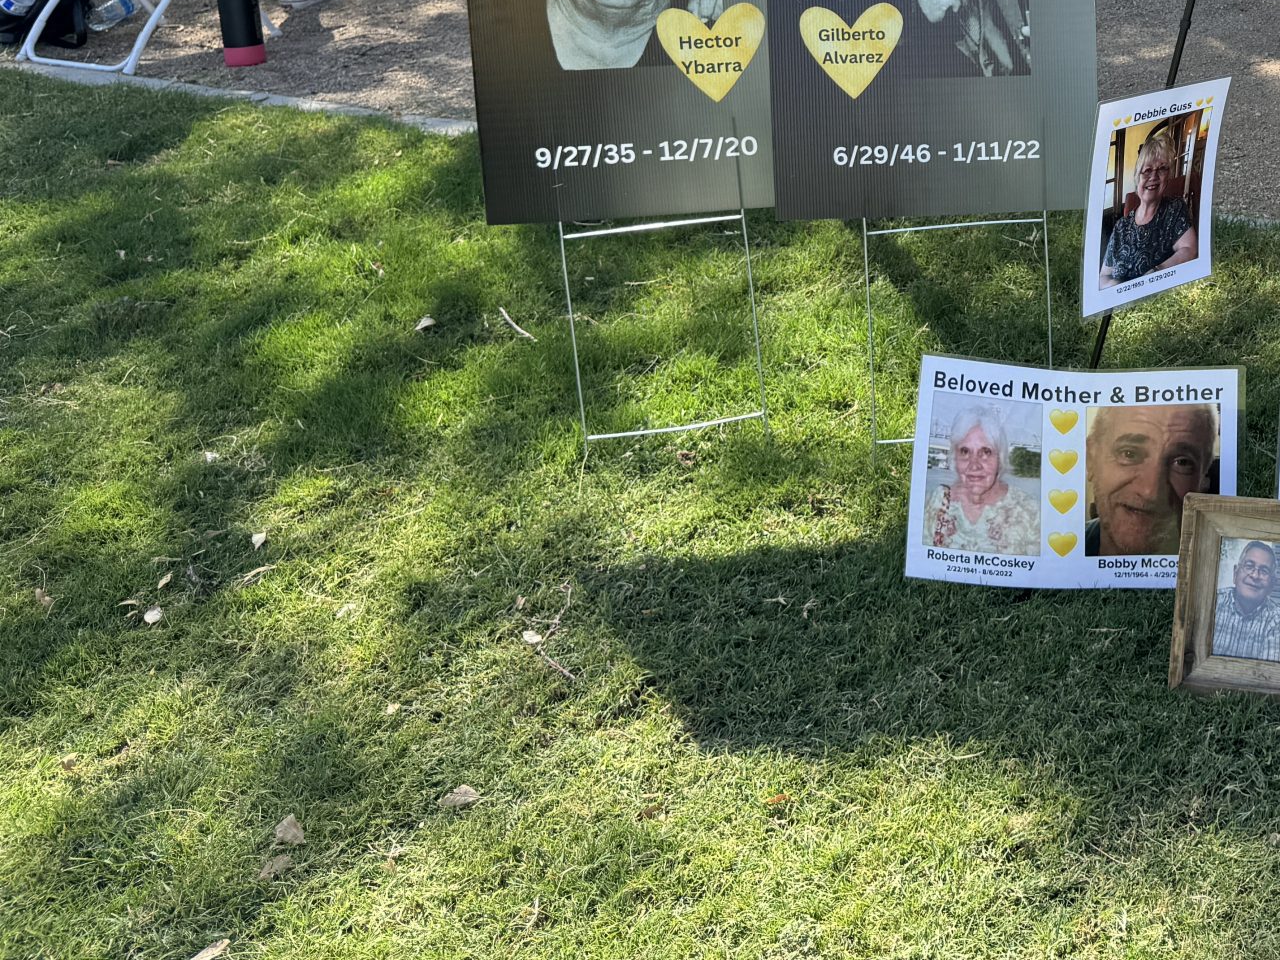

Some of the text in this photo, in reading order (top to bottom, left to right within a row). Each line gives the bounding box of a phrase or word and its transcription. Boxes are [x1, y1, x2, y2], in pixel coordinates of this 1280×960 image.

[678, 32, 742, 51] Hector
[818, 26, 886, 44] Gilberto
[681, 58, 743, 77] Ybarra
[822, 49, 884, 67] Alvarez
[1133, 101, 1192, 123] Debbie Guss
[535, 142, 636, 170] 9/27/35
[659, 135, 759, 164] 12/7/20
[832, 143, 932, 168] 6/29/46
[953, 140, 1041, 164] 1/11/22
[1148, 269, 1177, 284] 12/29/2021
[934, 370, 1224, 405] Beloved Mother & Brother
[927, 548, 1035, 571] Roberta McCoskey
[1098, 558, 1138, 571] Bobby
[946, 565, 977, 575] 2/22/1941
[982, 569, 1013, 577] 8/6/2022
